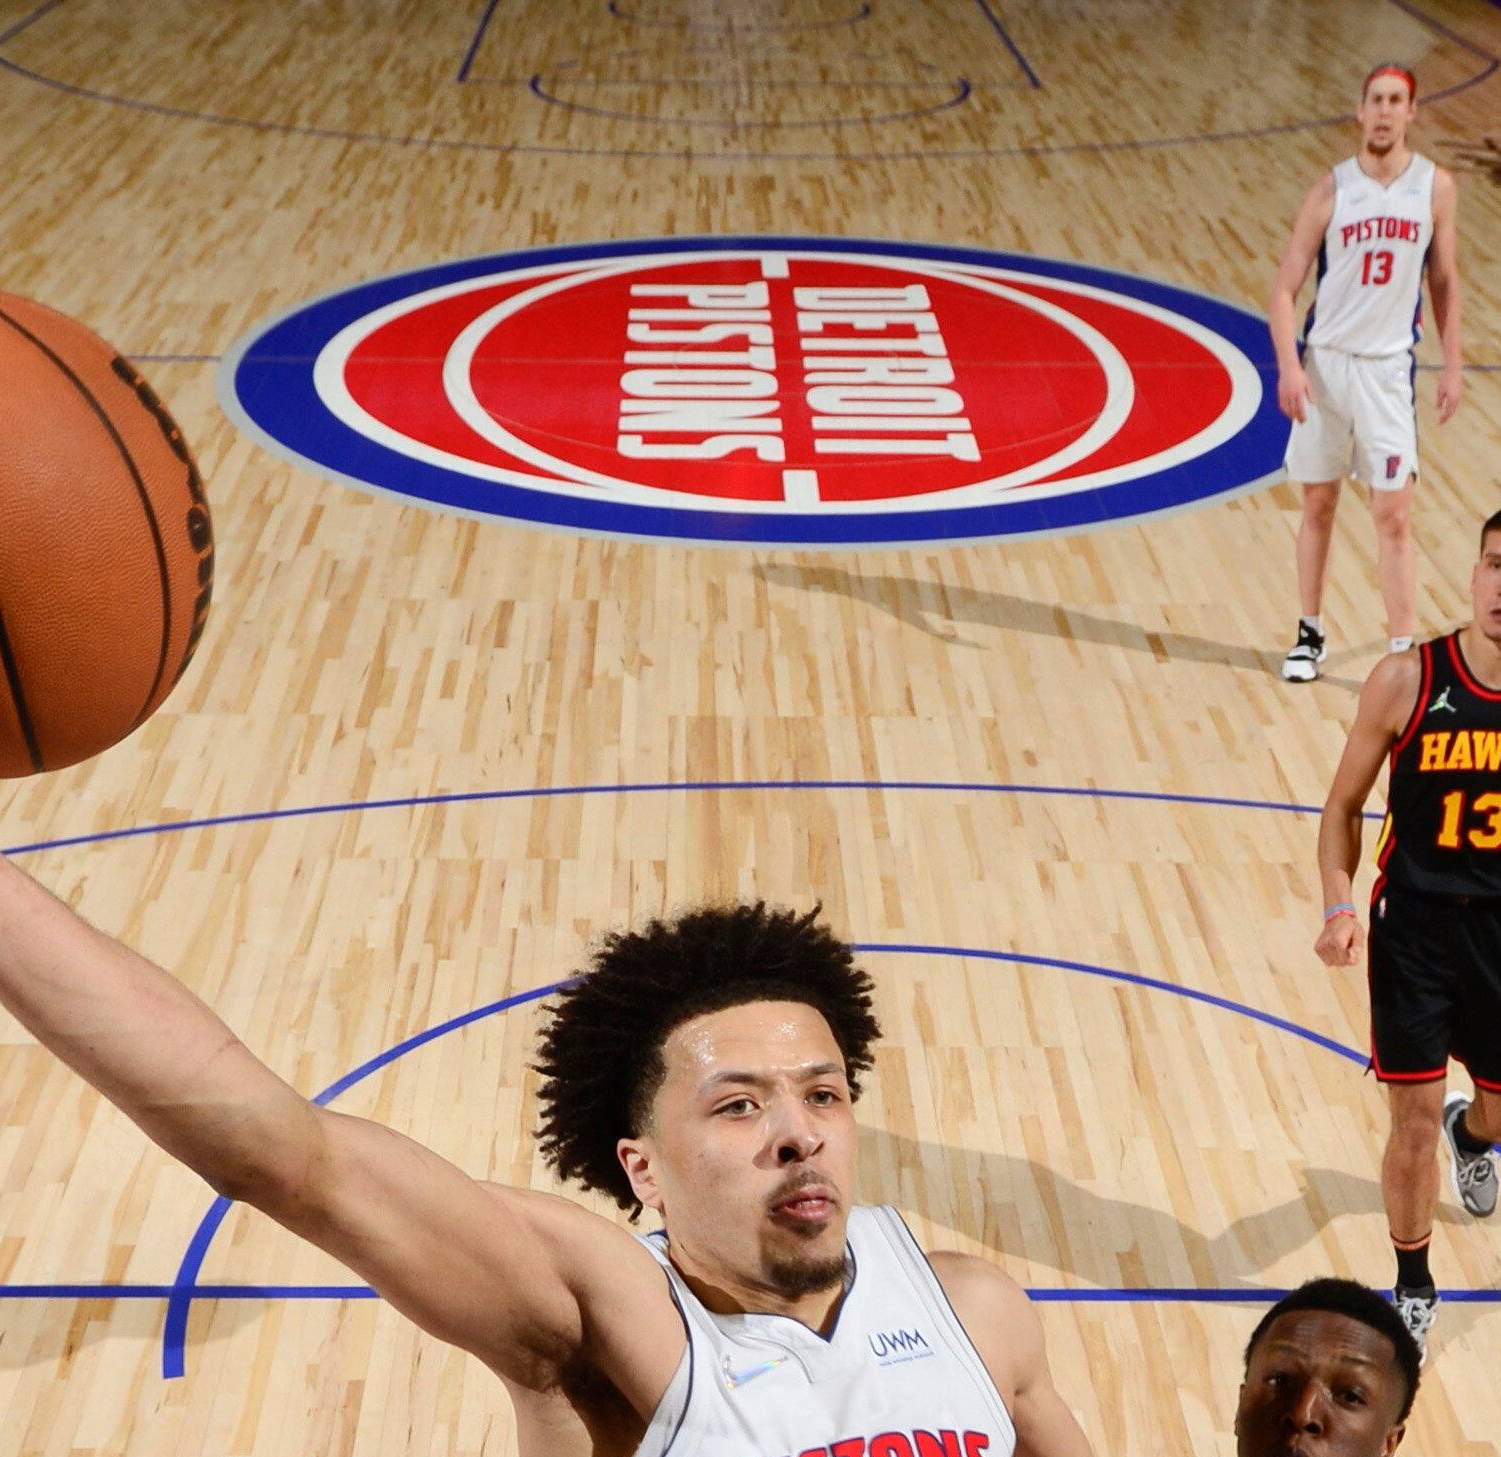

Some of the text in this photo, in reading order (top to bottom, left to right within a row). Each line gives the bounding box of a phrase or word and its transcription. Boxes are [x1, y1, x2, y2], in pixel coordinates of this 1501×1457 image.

[1341, 216, 1420, 248] PISTONS
[1362, 251, 1394, 286] 13
[617, 280, 786, 462] PISTONS
[793, 283, 981, 462] DETROIT
[868, 1327, 929, 1357] UWM
